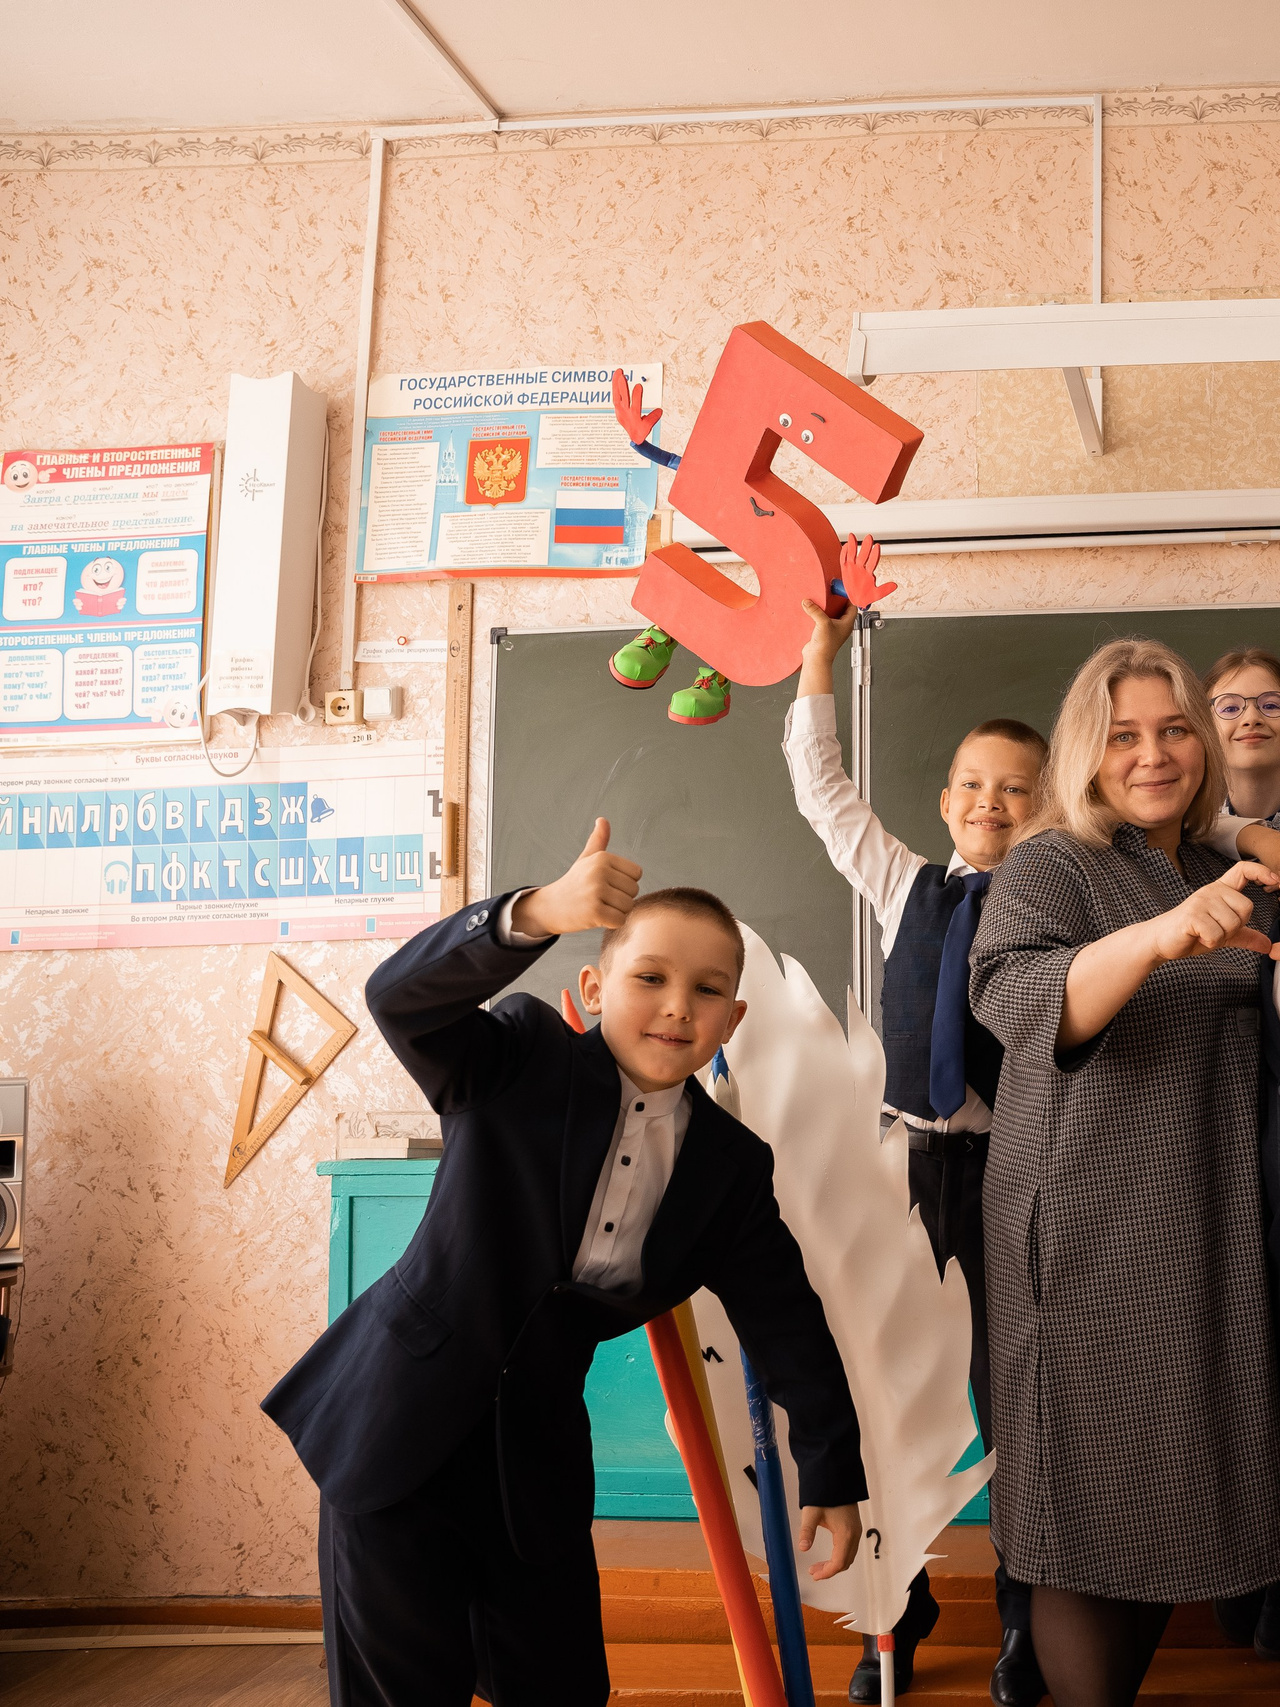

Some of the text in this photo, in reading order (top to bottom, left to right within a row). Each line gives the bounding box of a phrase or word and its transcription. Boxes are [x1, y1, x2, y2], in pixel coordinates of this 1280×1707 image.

[400, 371, 548, 391] ГОСУДАРСТВЕННЫЕ
[414, 391, 611, 410] РОССИЙСКОЙ ФЕДЕРАЦИИ
[36, 447, 201, 466] ГЛАВНЫЕ И ВТОРОСТЕПЕННЫЕ
[63, 461, 200, 479] ЧЛЕНЫ ПРЕДЛОЖЕНИЯ
[23, 494, 61, 504] Завтра
[74, 492, 139, 504] родителями
[28, 520, 109, 530] замечательное
[113, 515, 195, 528] представление.
[23, 538, 180, 556] ГЛАВНЫЕ ЧЛЕНЫ ПРЕДЛОЖЕНИЯ
[22, 597, 42, 607] что?
[87, 631, 121, 643] ЧЛЕНЫ
[125, 628, 195, 642] ПРЕДЛОЖЕНИЯ
[8, 649, 192, 662] ДОПОЛНЕНИЕ ОПРЕДЕЛЕНИЕ ОБСТОЯТЕЛЬСТВО
[135, 751, 238, 764] Буквы согласных звуков
[25, 778, 41, 787] ряду
[44, 777, 72, 785] звонкие
[74, 777, 109, 785] согласные
[22, 806, 42, 834] н
[49, 805, 74, 834] м
[81, 804, 101, 833] л
[108, 803, 129, 842] р
[137, 792, 156, 832] б
[165, 801, 184, 830] в
[196, 799, 210, 828] г
[220, 798, 244, 834] д
[253, 797, 272, 826] з
[280, 795, 305, 825] ж
[135, 863, 155, 892] п
[162, 852, 186, 901] ф
[192, 860, 212, 889] к
[222, 859, 241, 888] т
[254, 858, 270, 887] с
[280, 857, 304, 886] ш
[311, 856, 330, 885] х
[339, 854, 360, 890] ц
[369, 853, 388, 882] ч
[395, 851, 421, 888] щ
[204, 900, 258, 910] звонкие/глухие
[335, 896, 394, 905] Непарные глухие
[25, 907, 89, 916] Непарные звонкие
[169, 914, 185, 922] ряду
[187, 913, 210, 921] глухие
[212, 912, 248, 920] согласные
[249, 910, 269, 920] звуки
[866, 1528, 882, 1560] ?
